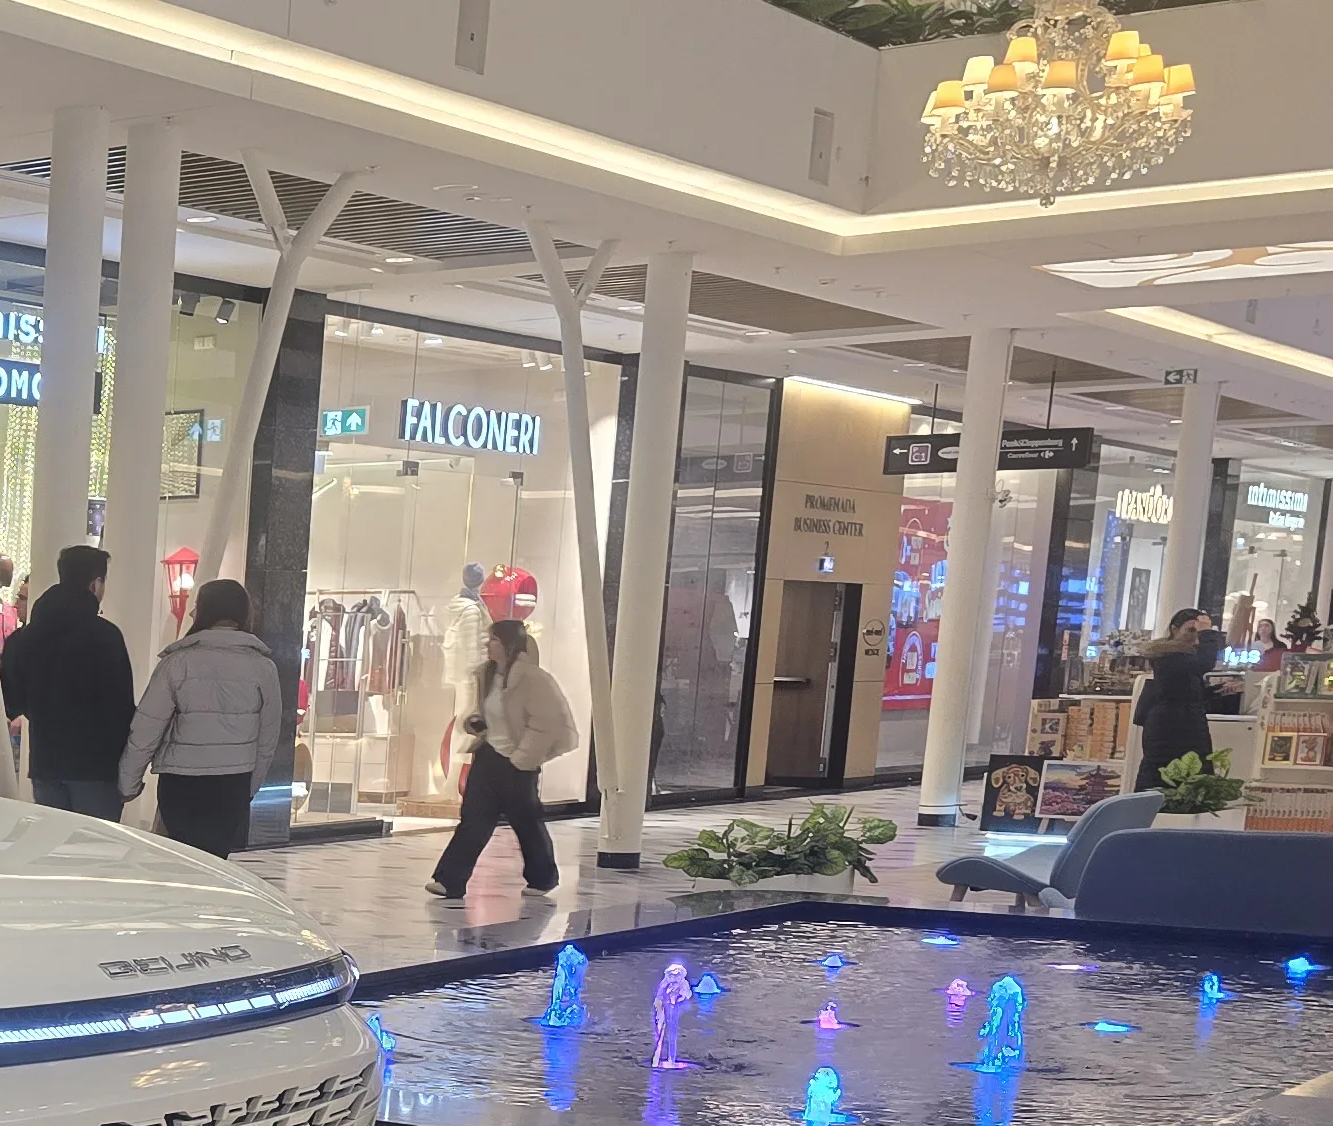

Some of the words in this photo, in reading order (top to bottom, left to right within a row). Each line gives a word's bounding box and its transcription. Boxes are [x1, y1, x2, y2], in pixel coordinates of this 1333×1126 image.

[404, 398, 540, 455] FALCONERI
[913, 453, 925, 461] C1
[804, 494, 856, 514] PROMENADA
[794, 516, 831, 534] BUSINESS
[832, 519, 864, 537] CENTER
[98, 944, 251, 980] BEIJING
